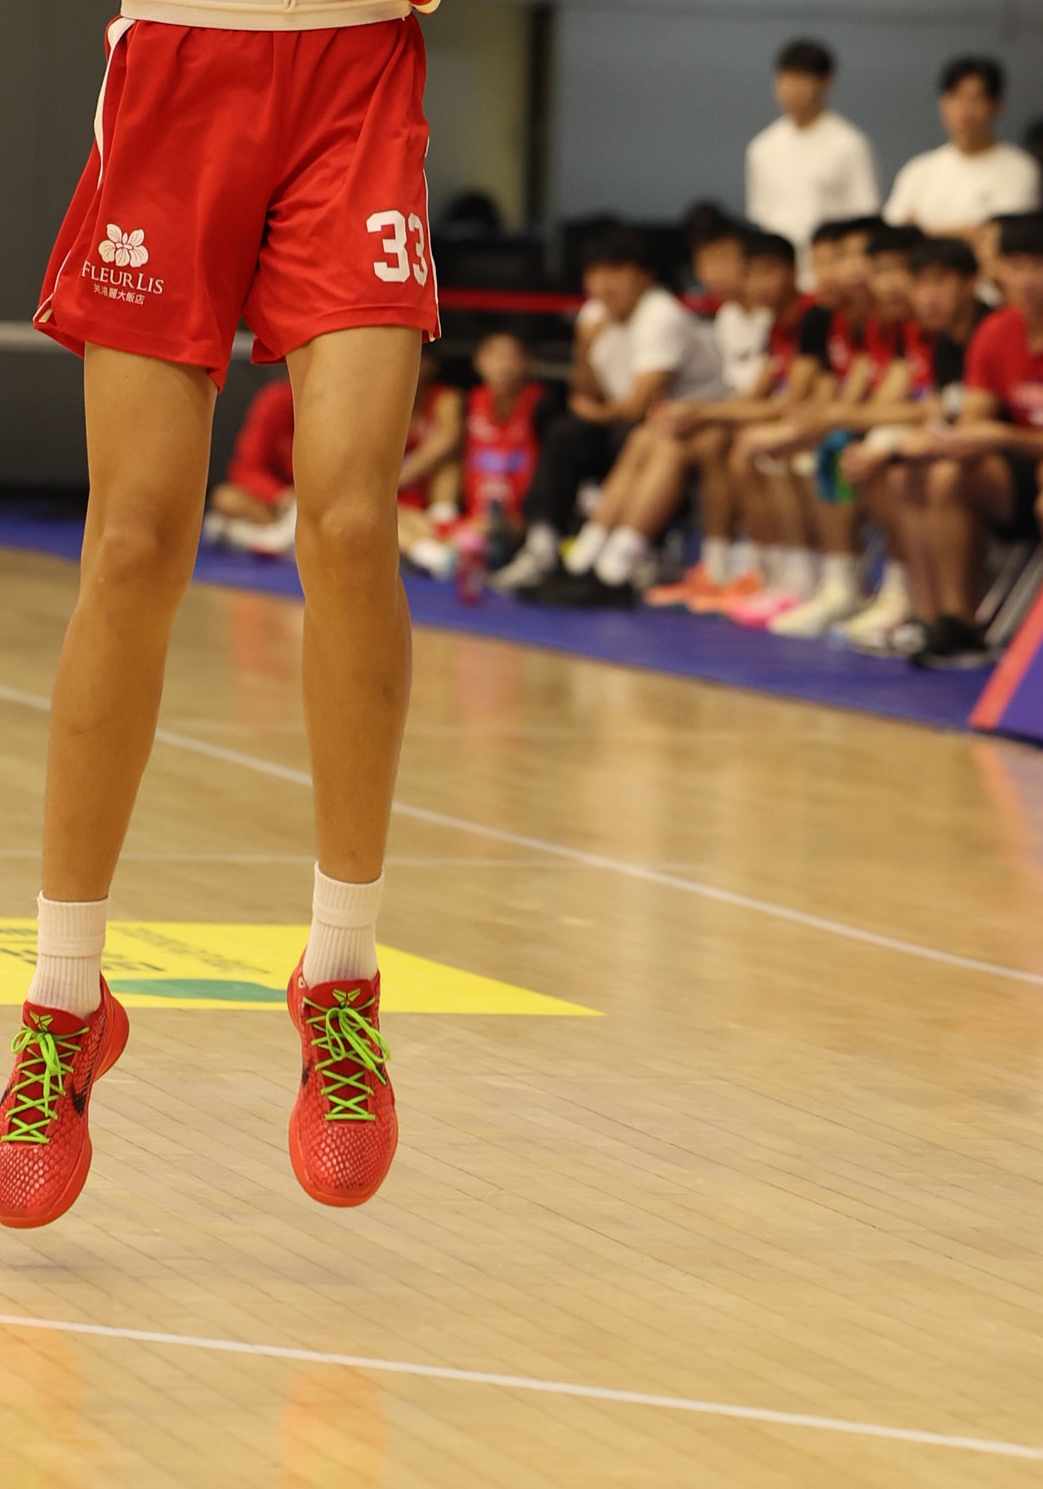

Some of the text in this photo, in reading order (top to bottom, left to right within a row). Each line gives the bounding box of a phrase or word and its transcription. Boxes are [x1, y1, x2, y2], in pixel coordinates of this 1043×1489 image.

[365, 209, 429, 288] 33
[81, 260, 165, 295] FLEUR LIS
